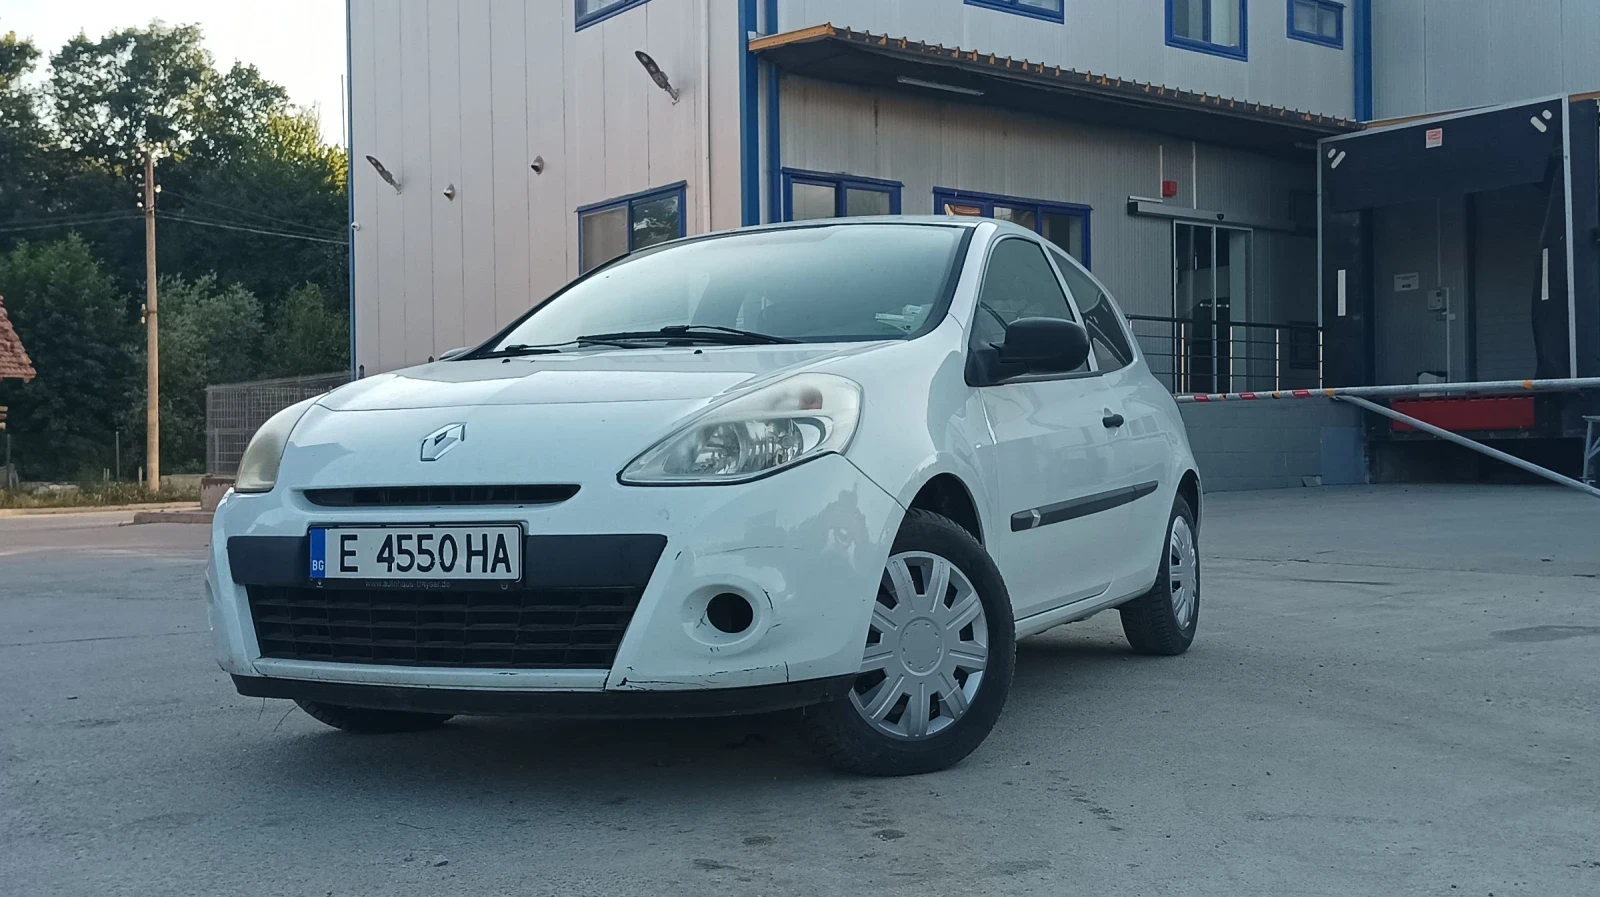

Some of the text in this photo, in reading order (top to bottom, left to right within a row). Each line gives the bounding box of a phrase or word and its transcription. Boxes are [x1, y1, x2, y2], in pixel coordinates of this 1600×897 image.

[312, 559, 324, 571] BG
[339, 533, 512, 573] E 4550 HA
